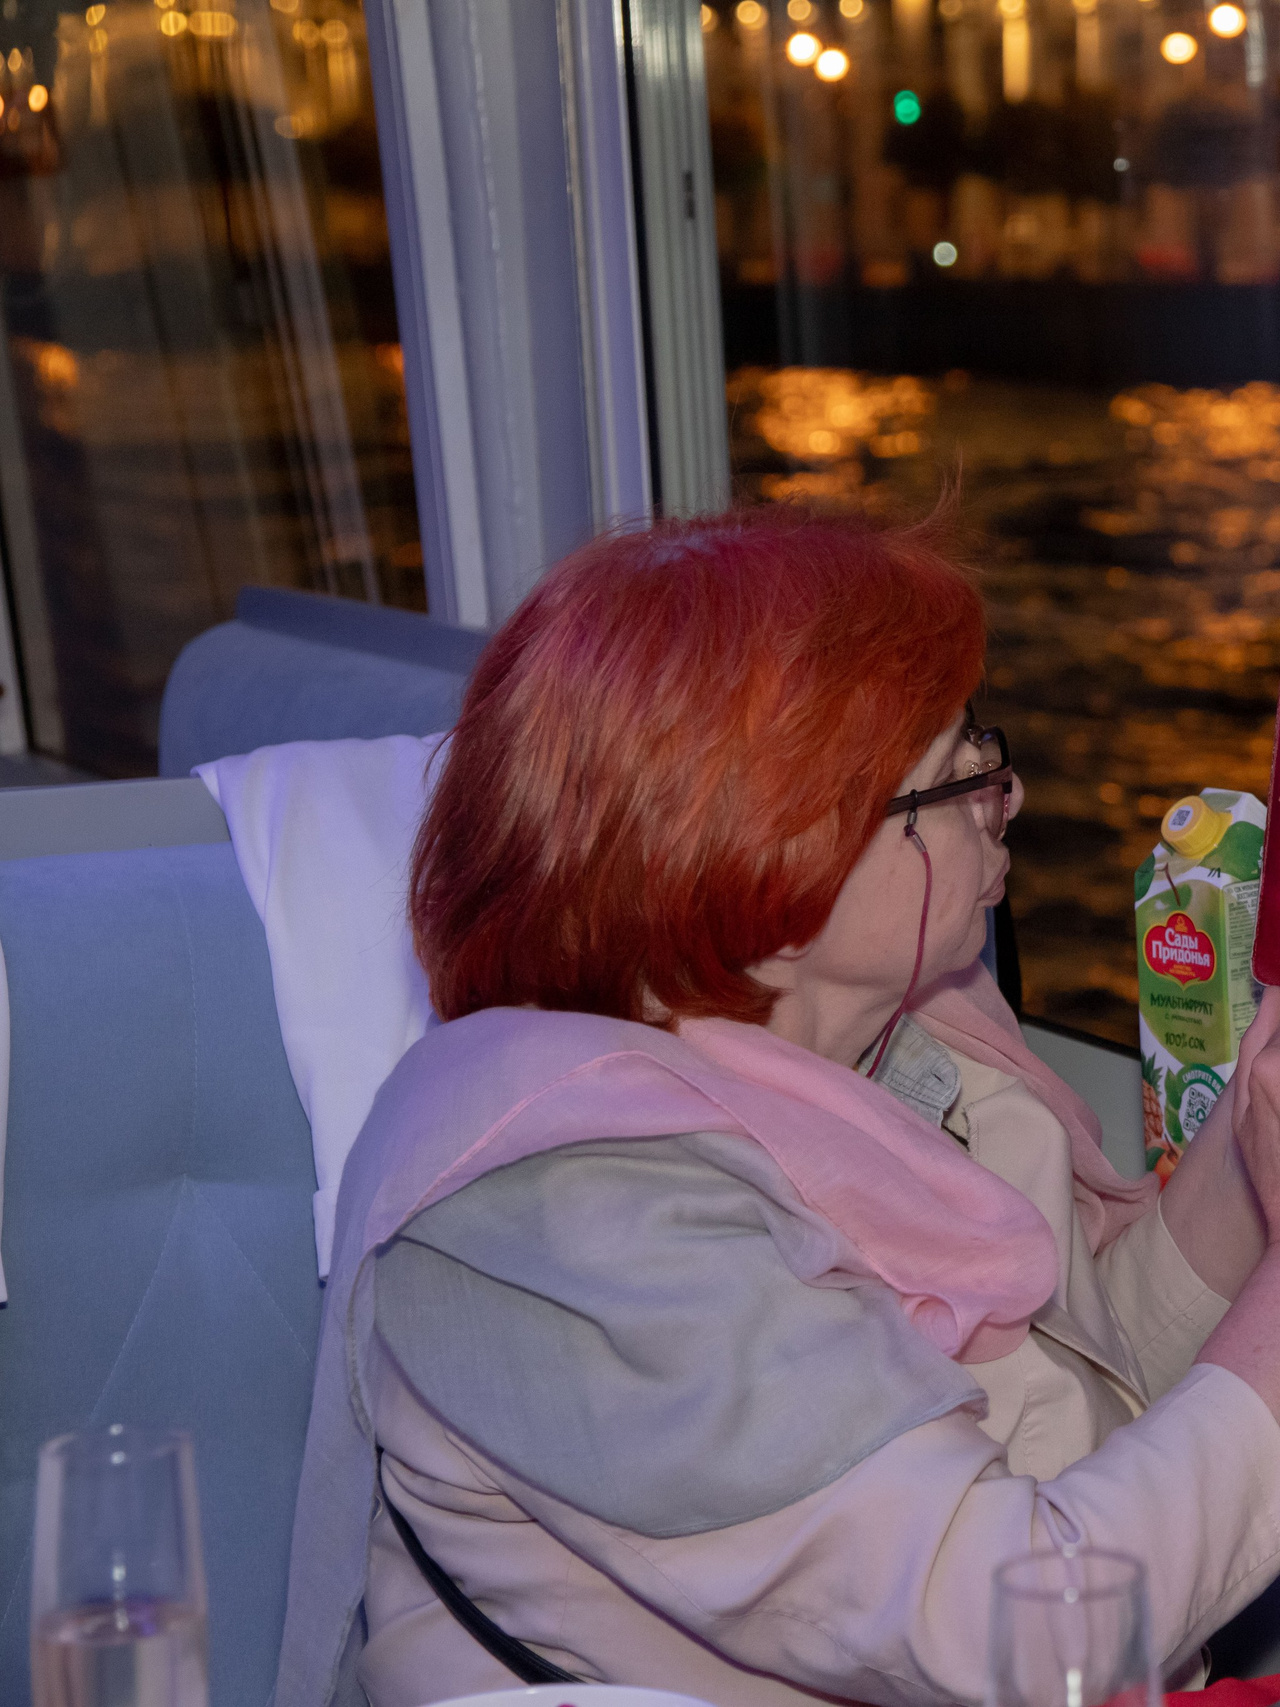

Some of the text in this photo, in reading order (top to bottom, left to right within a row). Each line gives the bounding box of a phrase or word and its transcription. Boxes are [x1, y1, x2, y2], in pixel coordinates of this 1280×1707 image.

[1164, 927, 1199, 950] Сады
[1151, 941, 1212, 968] Придонья
[1150, 993, 1214, 1016] МУЛЬТИФРУКТ
[1164, 1031, 1206, 1052] 100% СОК
